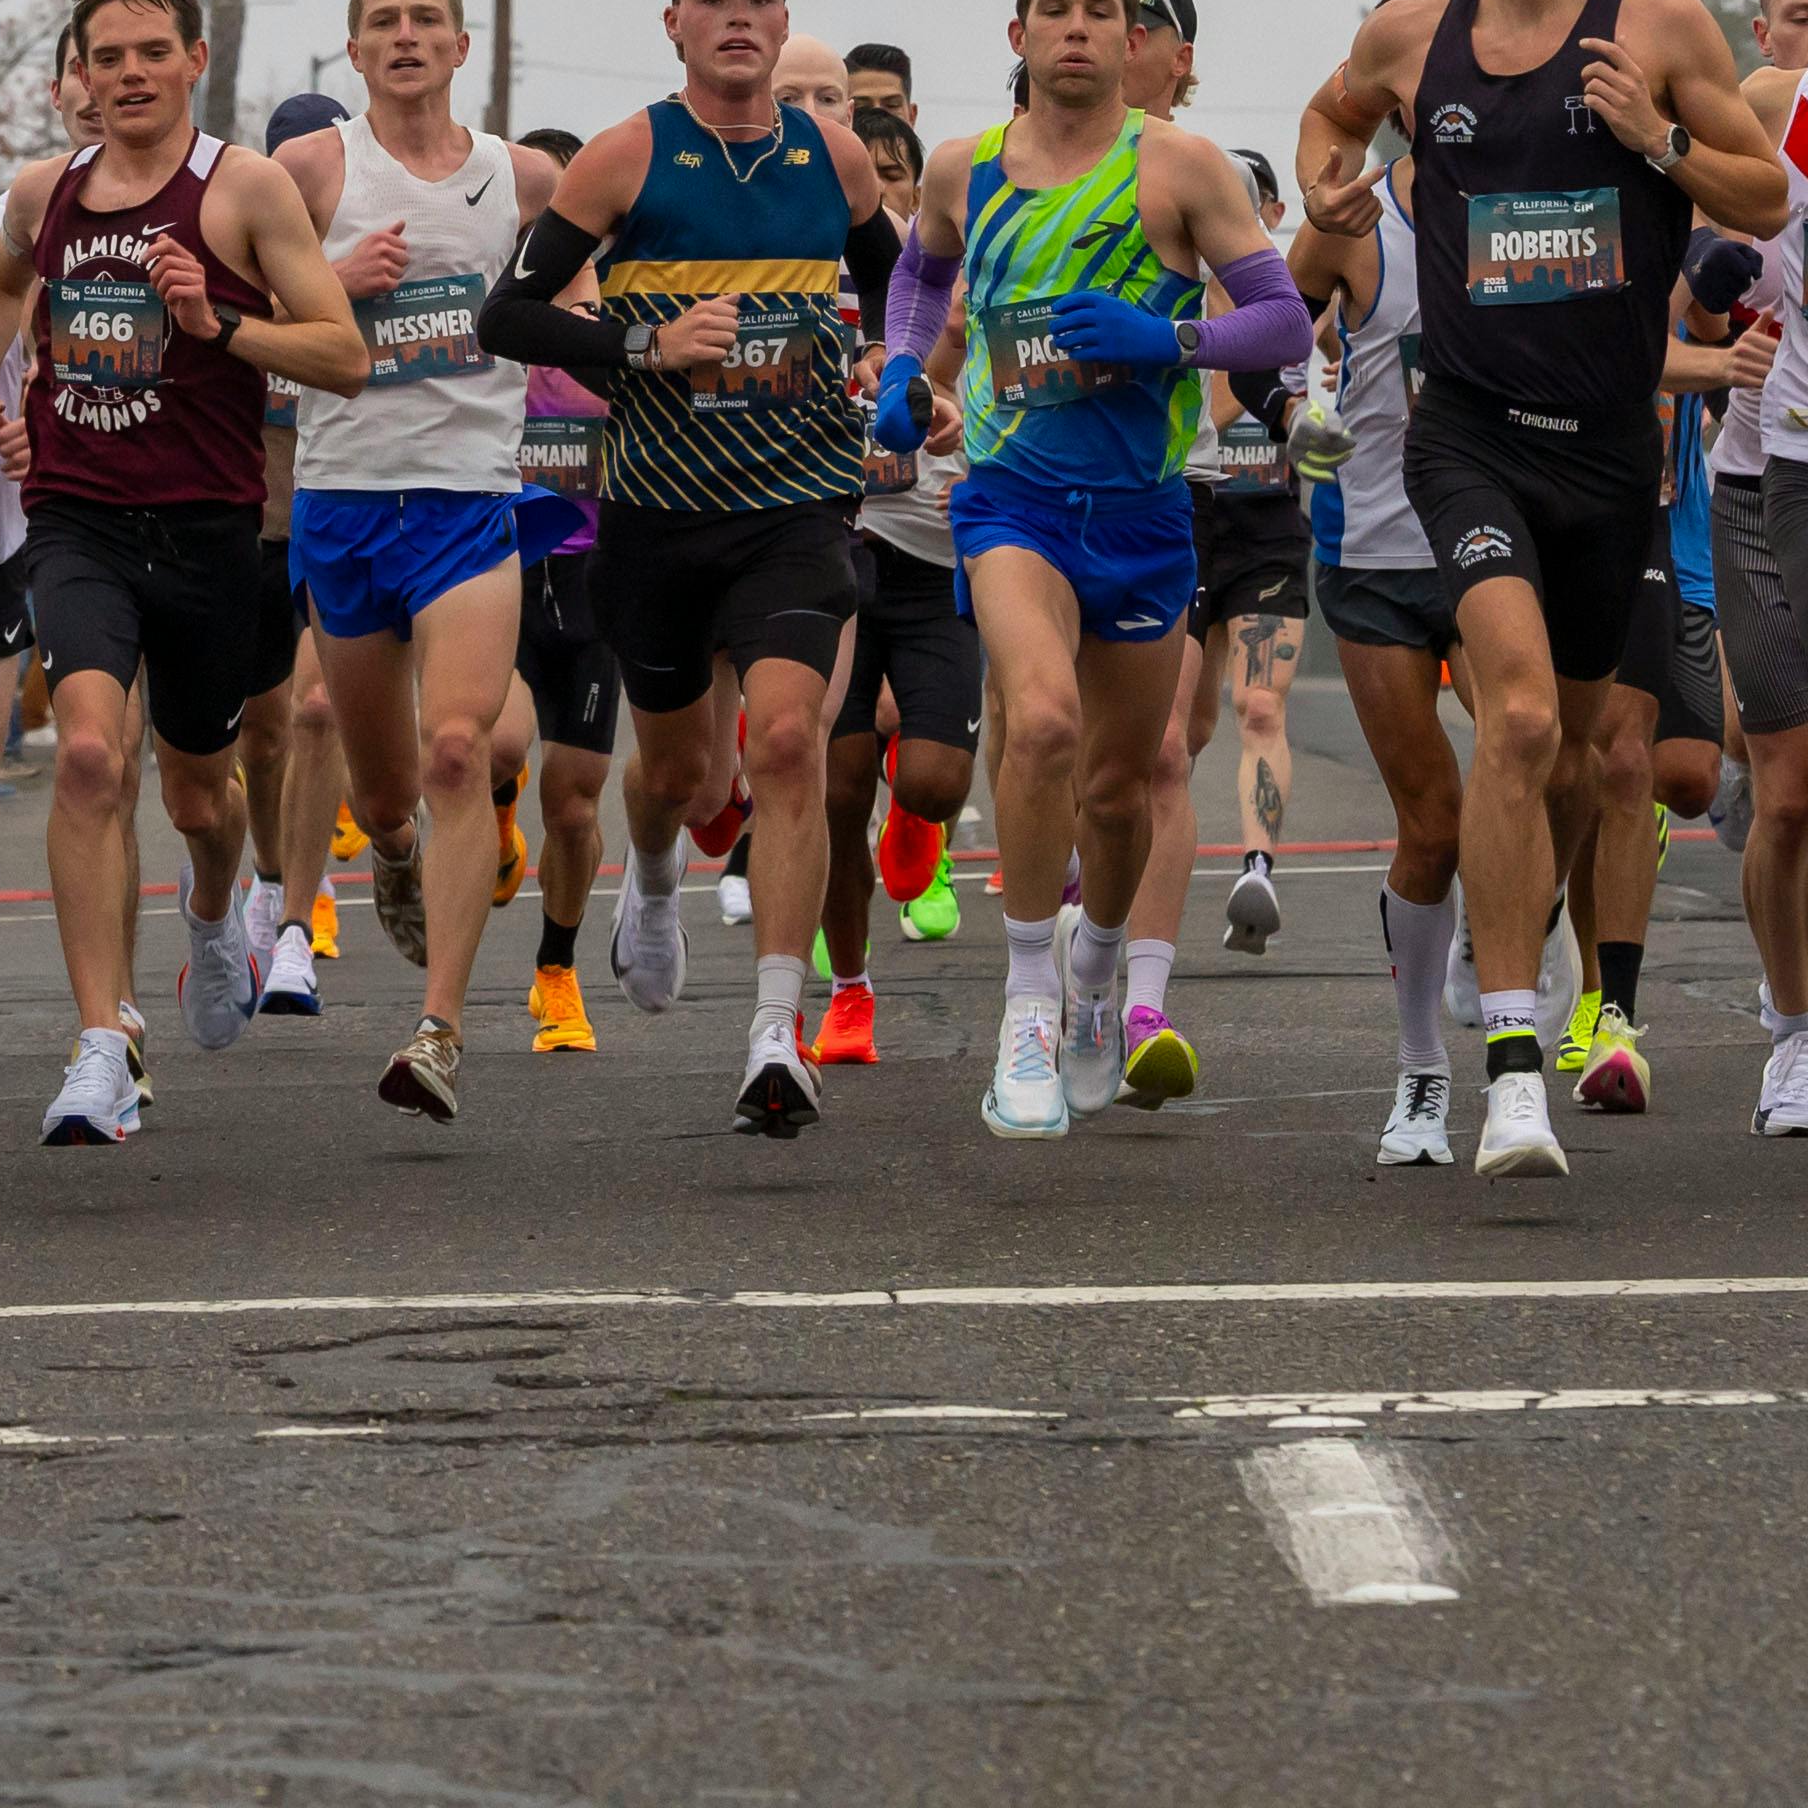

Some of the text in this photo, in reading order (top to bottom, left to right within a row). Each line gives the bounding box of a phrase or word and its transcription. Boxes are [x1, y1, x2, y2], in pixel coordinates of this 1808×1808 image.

[1512, 200, 1594, 213] CALIFORNIA CIM
[1491, 227, 1597, 262] ROBERTS
[63, 234, 160, 276] ALMIGH
[1484, 277, 1507, 285] 2025
[1586, 279, 1604, 288] 145
[61, 286, 146, 301] CIM CALIFORNIA
[394, 285, 445, 299] CALIFORNIA
[449, 286, 467, 297] CIM
[1484, 285, 1508, 293] ELITE
[1017, 305, 1052, 319] CALIFOR
[69, 310, 134, 342] 466
[375, 309, 475, 347] MESSMER
[376, 366, 399, 376] ELITE
[53, 389, 162, 433] ALMONDS
[694, 399, 749, 409] MARATHON
[1521, 412, 1579, 433] CHICKNLEGS
[1218, 445, 1277, 465] GRAHAM
[1460, 527, 1481, 542] LUIS
[1483, 525, 1512, 543] OBISPO
[1460, 553, 1488, 569] TRACK
